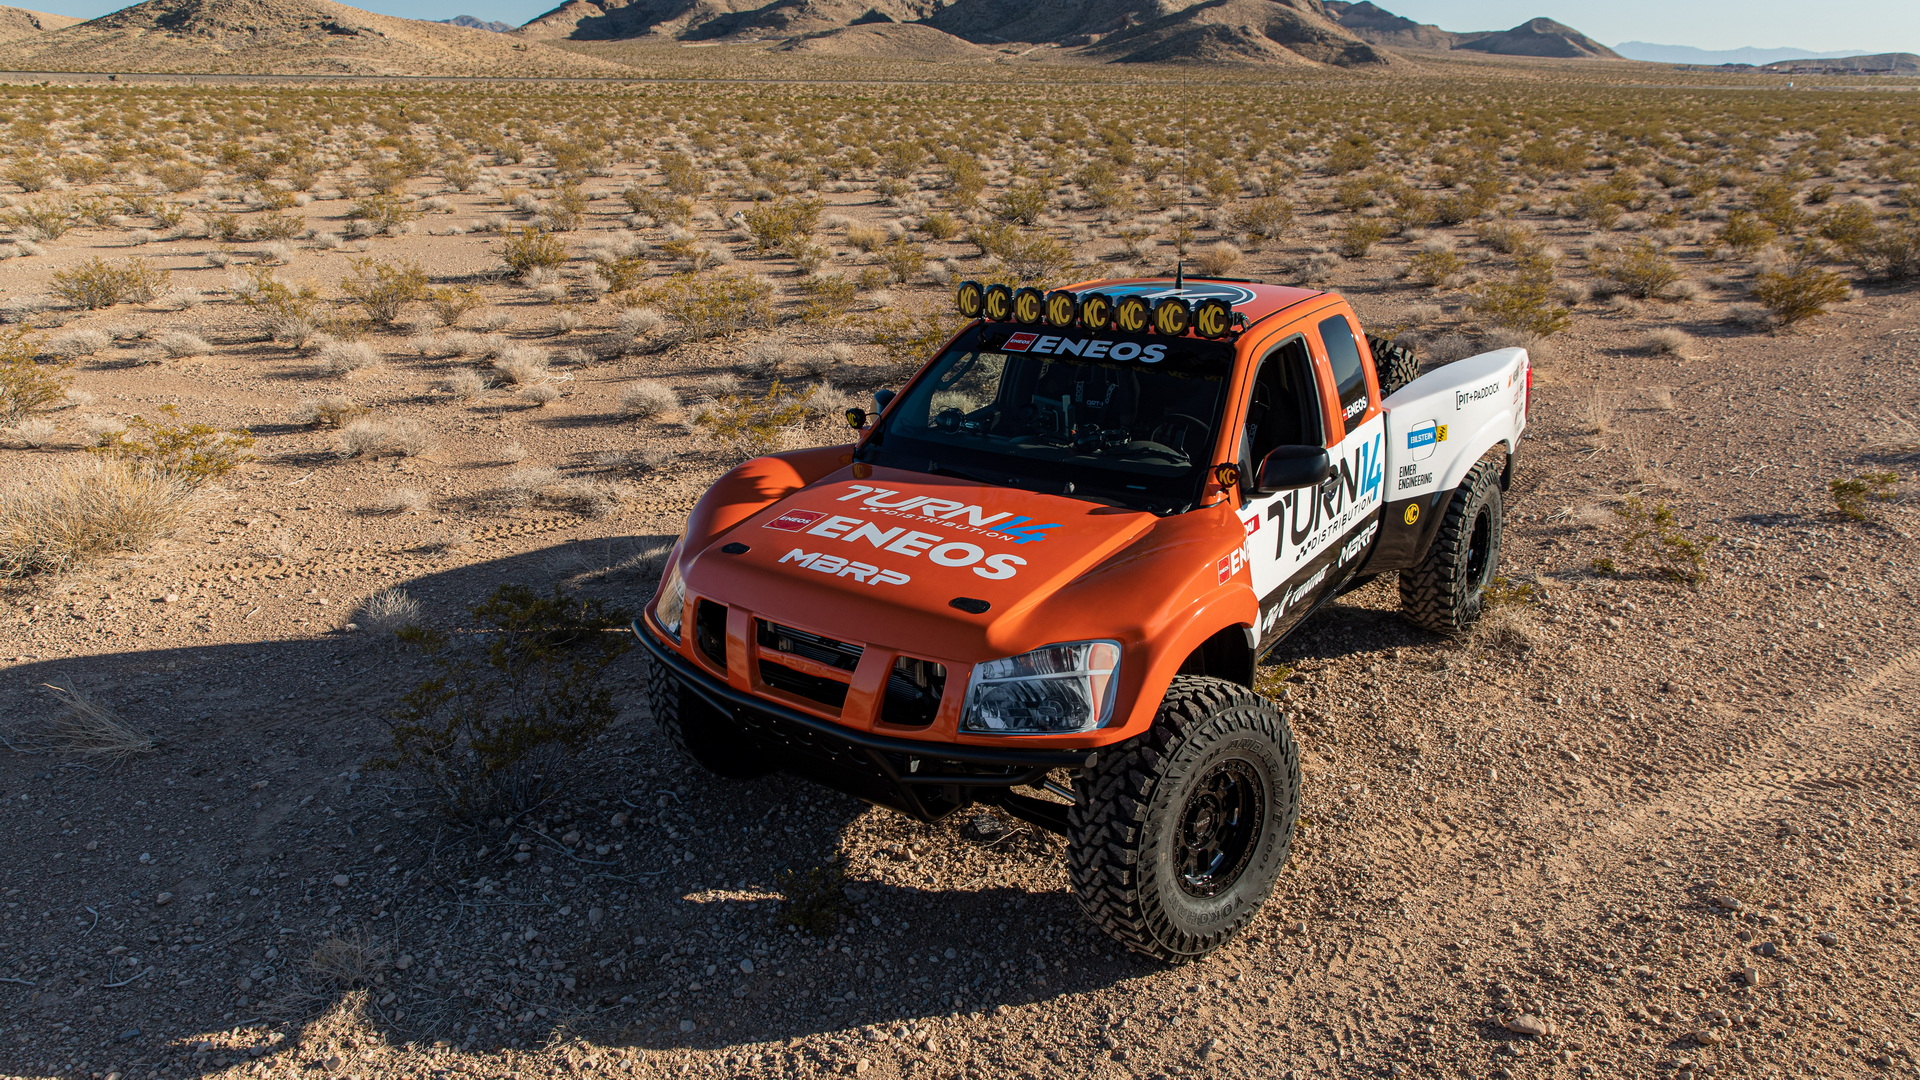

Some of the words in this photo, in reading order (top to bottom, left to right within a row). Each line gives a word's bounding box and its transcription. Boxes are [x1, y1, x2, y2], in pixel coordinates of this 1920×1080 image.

[960, 286, 977, 314] KC
[987, 290, 1006, 318] KC
[1017, 293, 1036, 322] KC
[1049, 296, 1070, 324] KC
[1084, 300, 1106, 328] KC
[1120, 302, 1144, 331] KC
[1158, 303, 1183, 333] KC
[1199, 305, 1225, 335] KC
[1031, 335, 1168, 363] ENEOS
[847, 412, 857, 427] KC
[1346, 396, 1367, 419] ENEOS
[1411, 432, 1433, 444] BILSTEIN
[1219, 468, 1236, 485] KC
[1398, 472, 1433, 490] ENGINEERING
[1399, 464, 1417, 478] EIMER
[886, 510, 1014, 542] DISTRIBUTION
[1311, 494, 1373, 550] DISTRIBUTION
[1406, 505, 1418, 523] KC
[779, 516, 811, 524] ENEOS
[805, 515, 1028, 580] ENEOS
[1338, 520, 1379, 568] MBRP
[777, 548, 911, 586] MBRP
